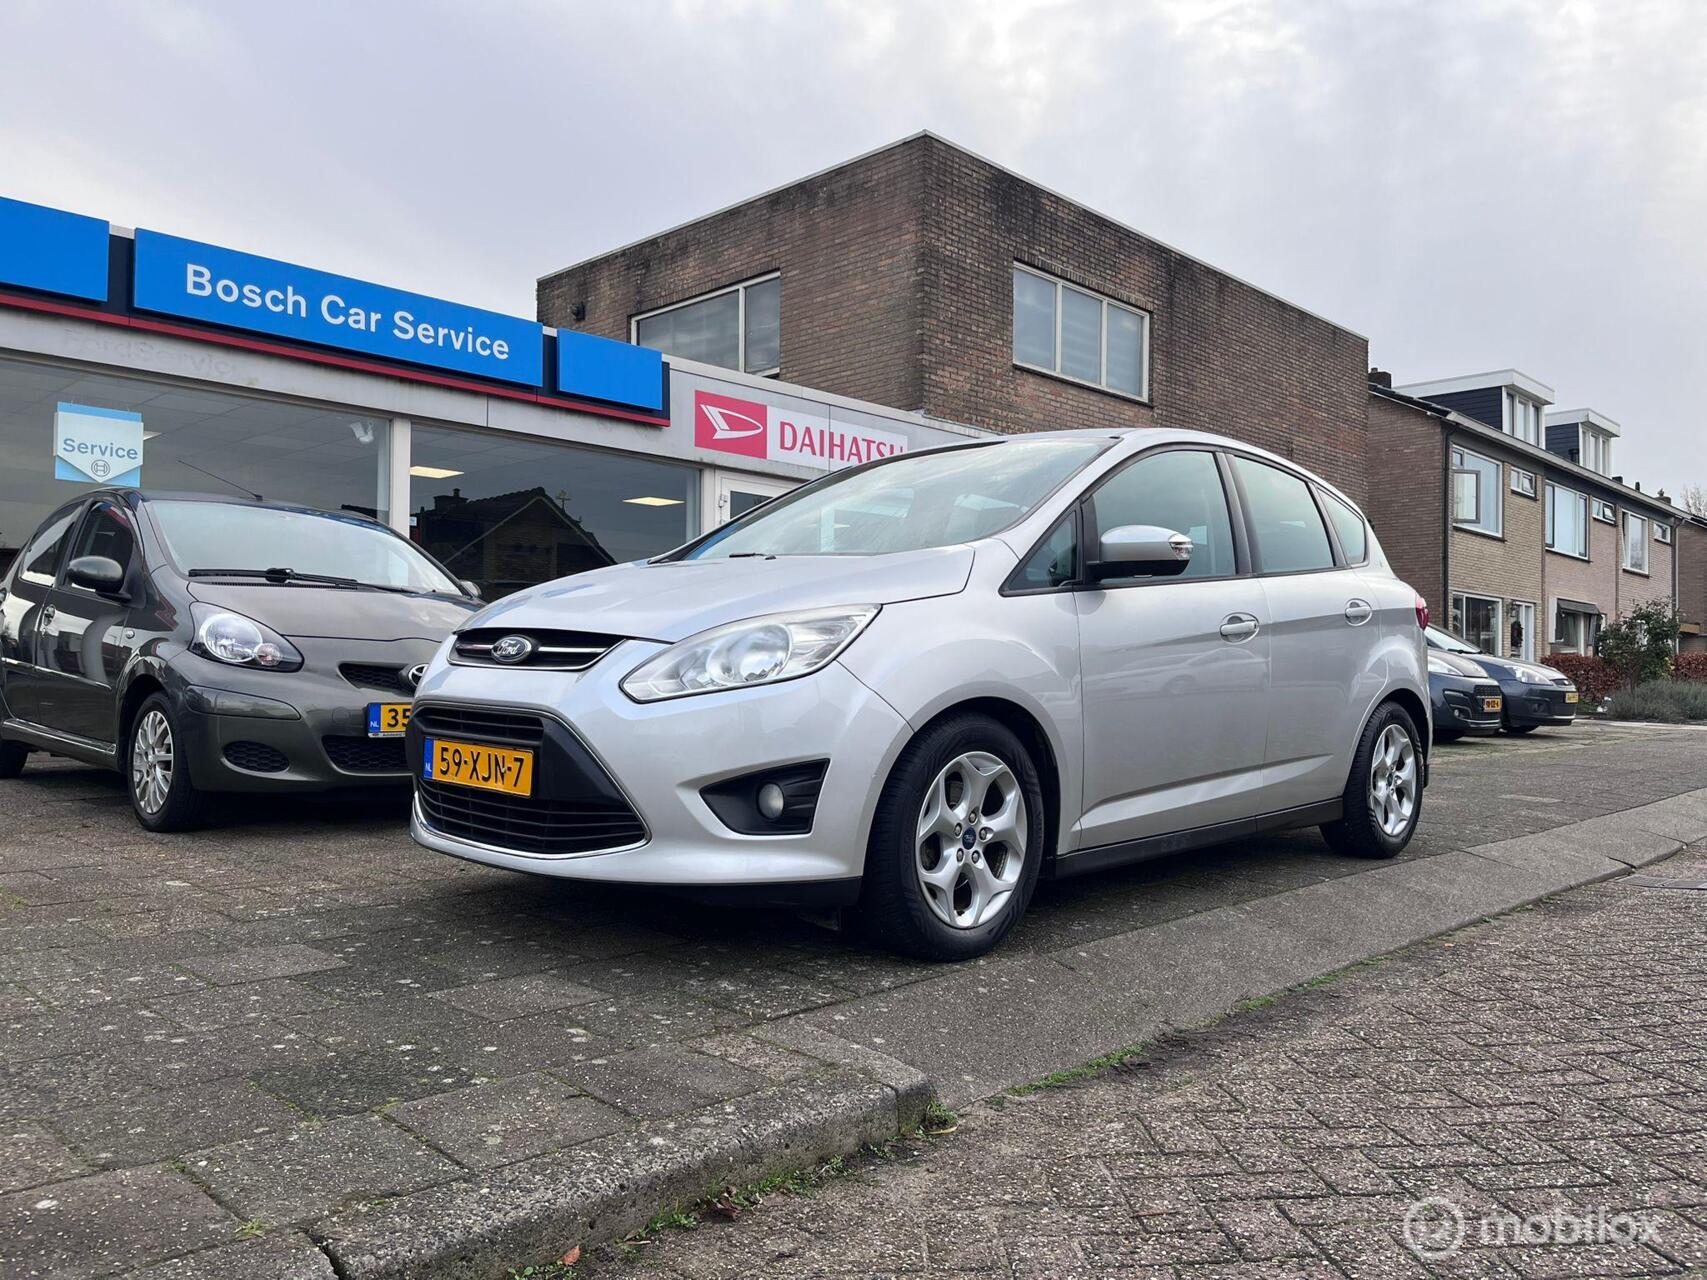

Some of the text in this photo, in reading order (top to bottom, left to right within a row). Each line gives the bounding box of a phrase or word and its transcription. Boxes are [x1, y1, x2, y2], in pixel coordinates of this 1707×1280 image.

[186, 263, 510, 360] Bosch Car Service
[62, 438, 138, 460] Service
[496, 639, 521, 655] Ford
[424, 746, 525, 788] NL 59-XJN-7
